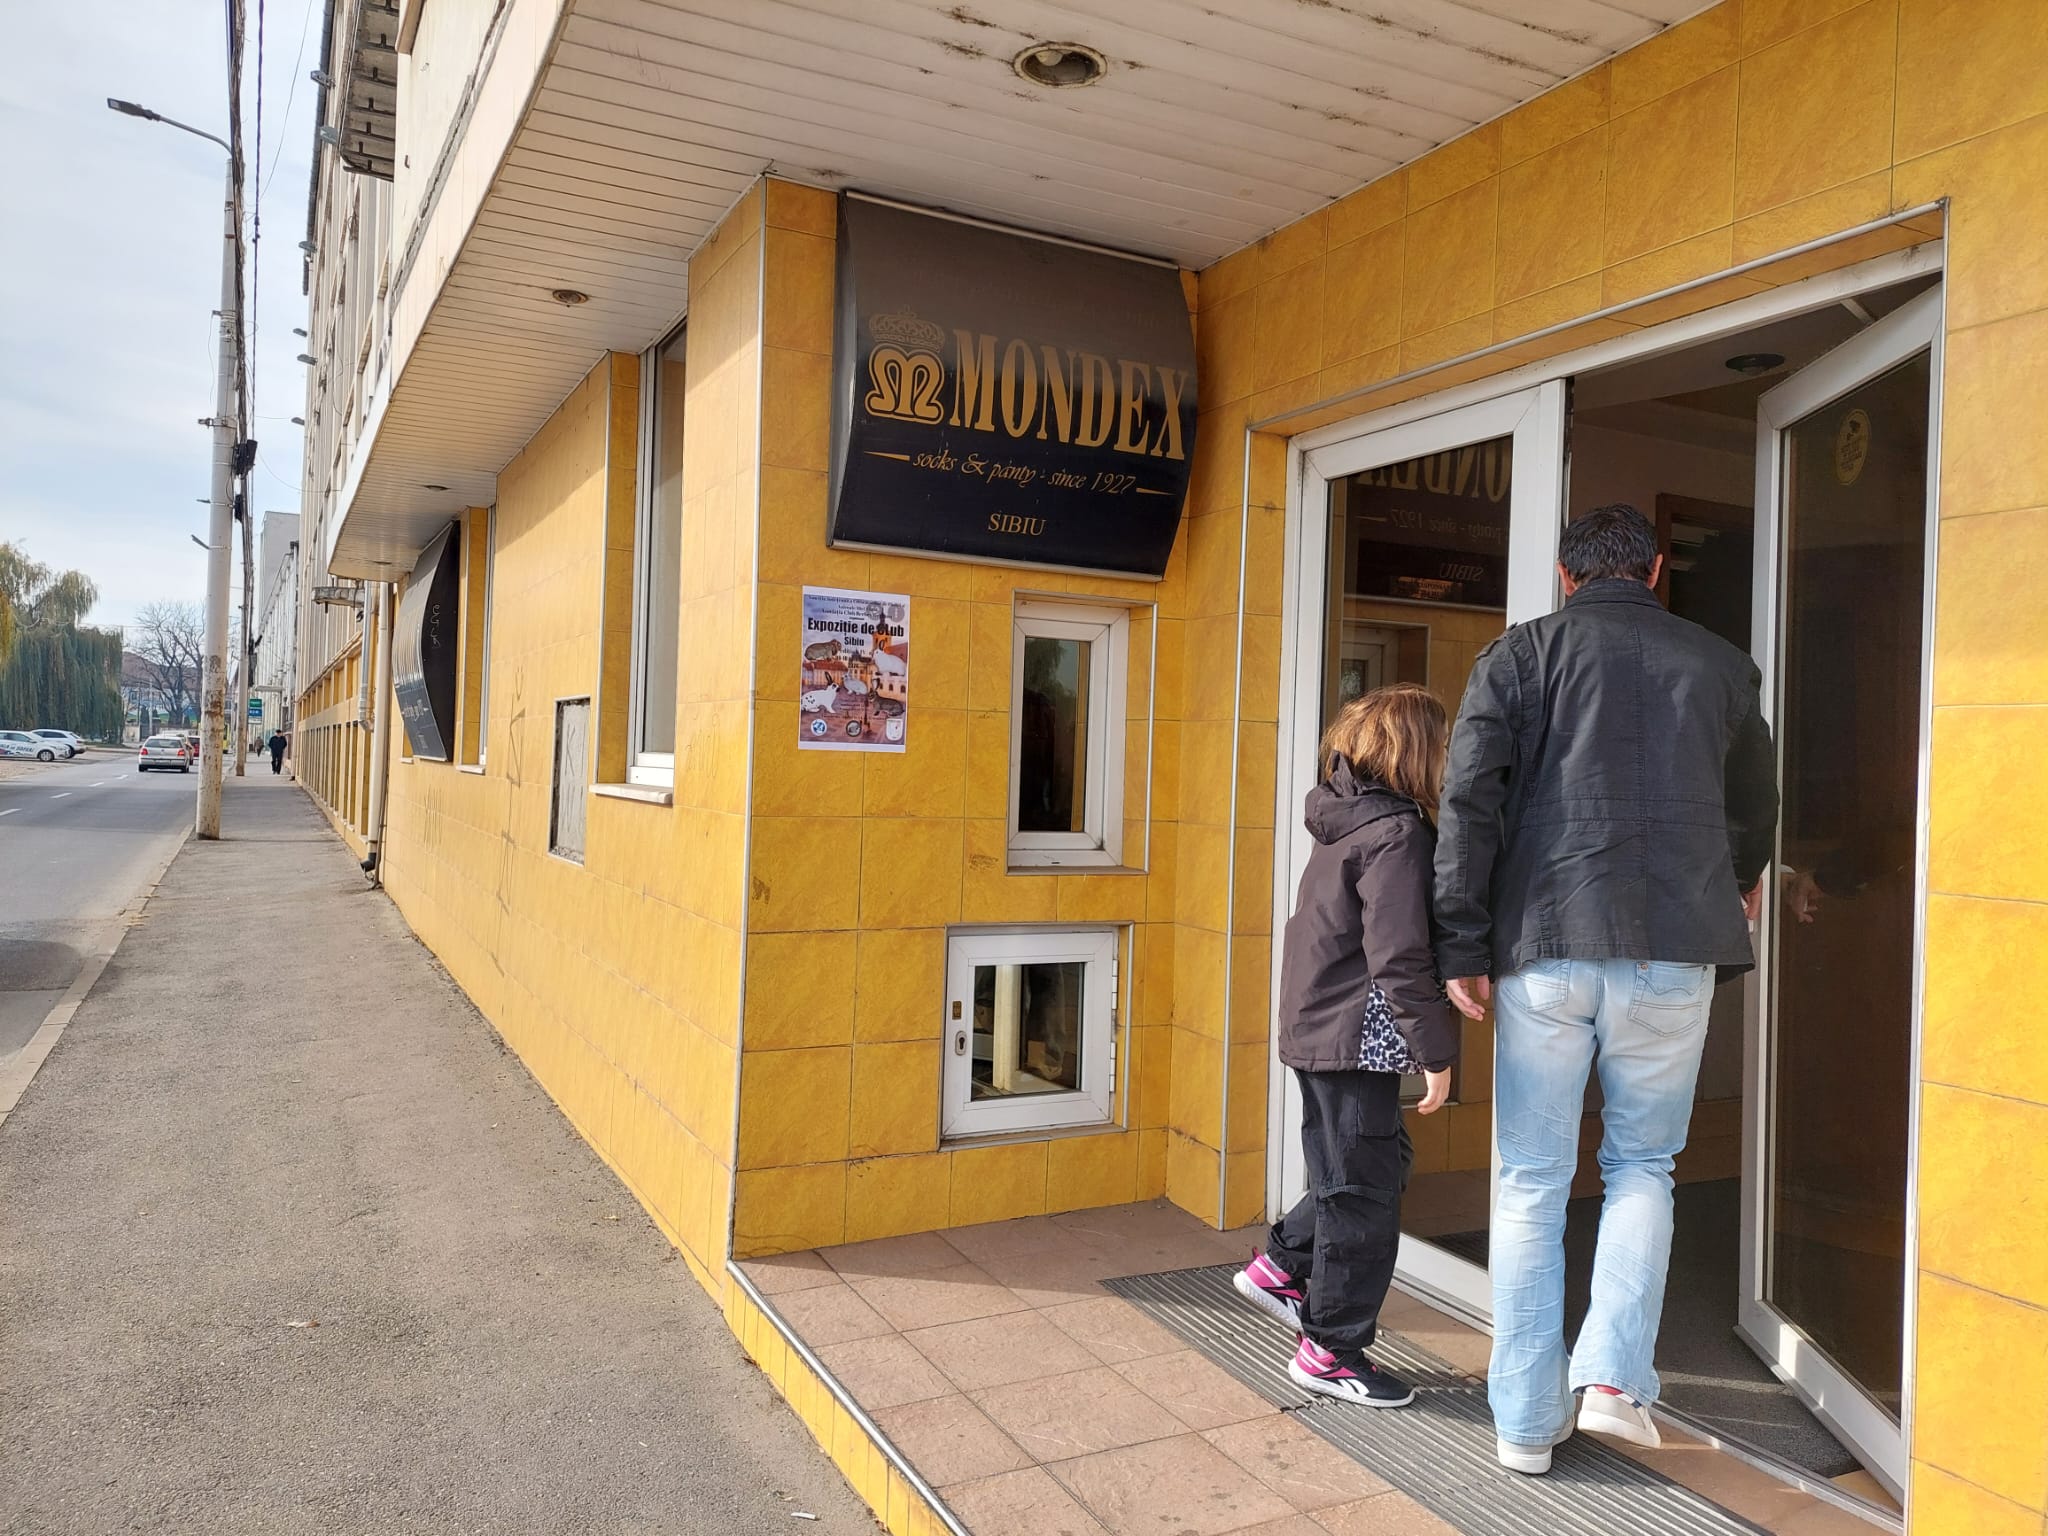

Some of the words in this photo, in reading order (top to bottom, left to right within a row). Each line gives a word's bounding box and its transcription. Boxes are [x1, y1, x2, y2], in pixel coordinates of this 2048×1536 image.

[949, 329, 1189, 461] MONDEX
[912, 449, 958, 471] socks
[961, 453, 989, 475] &
[986, 463, 1036, 488] panty
[1048, 471, 1087, 488] since
[1091, 472, 1136, 495] 1927
[988, 511, 1046, 536] SIBIU
[844, 636, 865, 646] Sibiu
[861, 622, 874, 635] de
